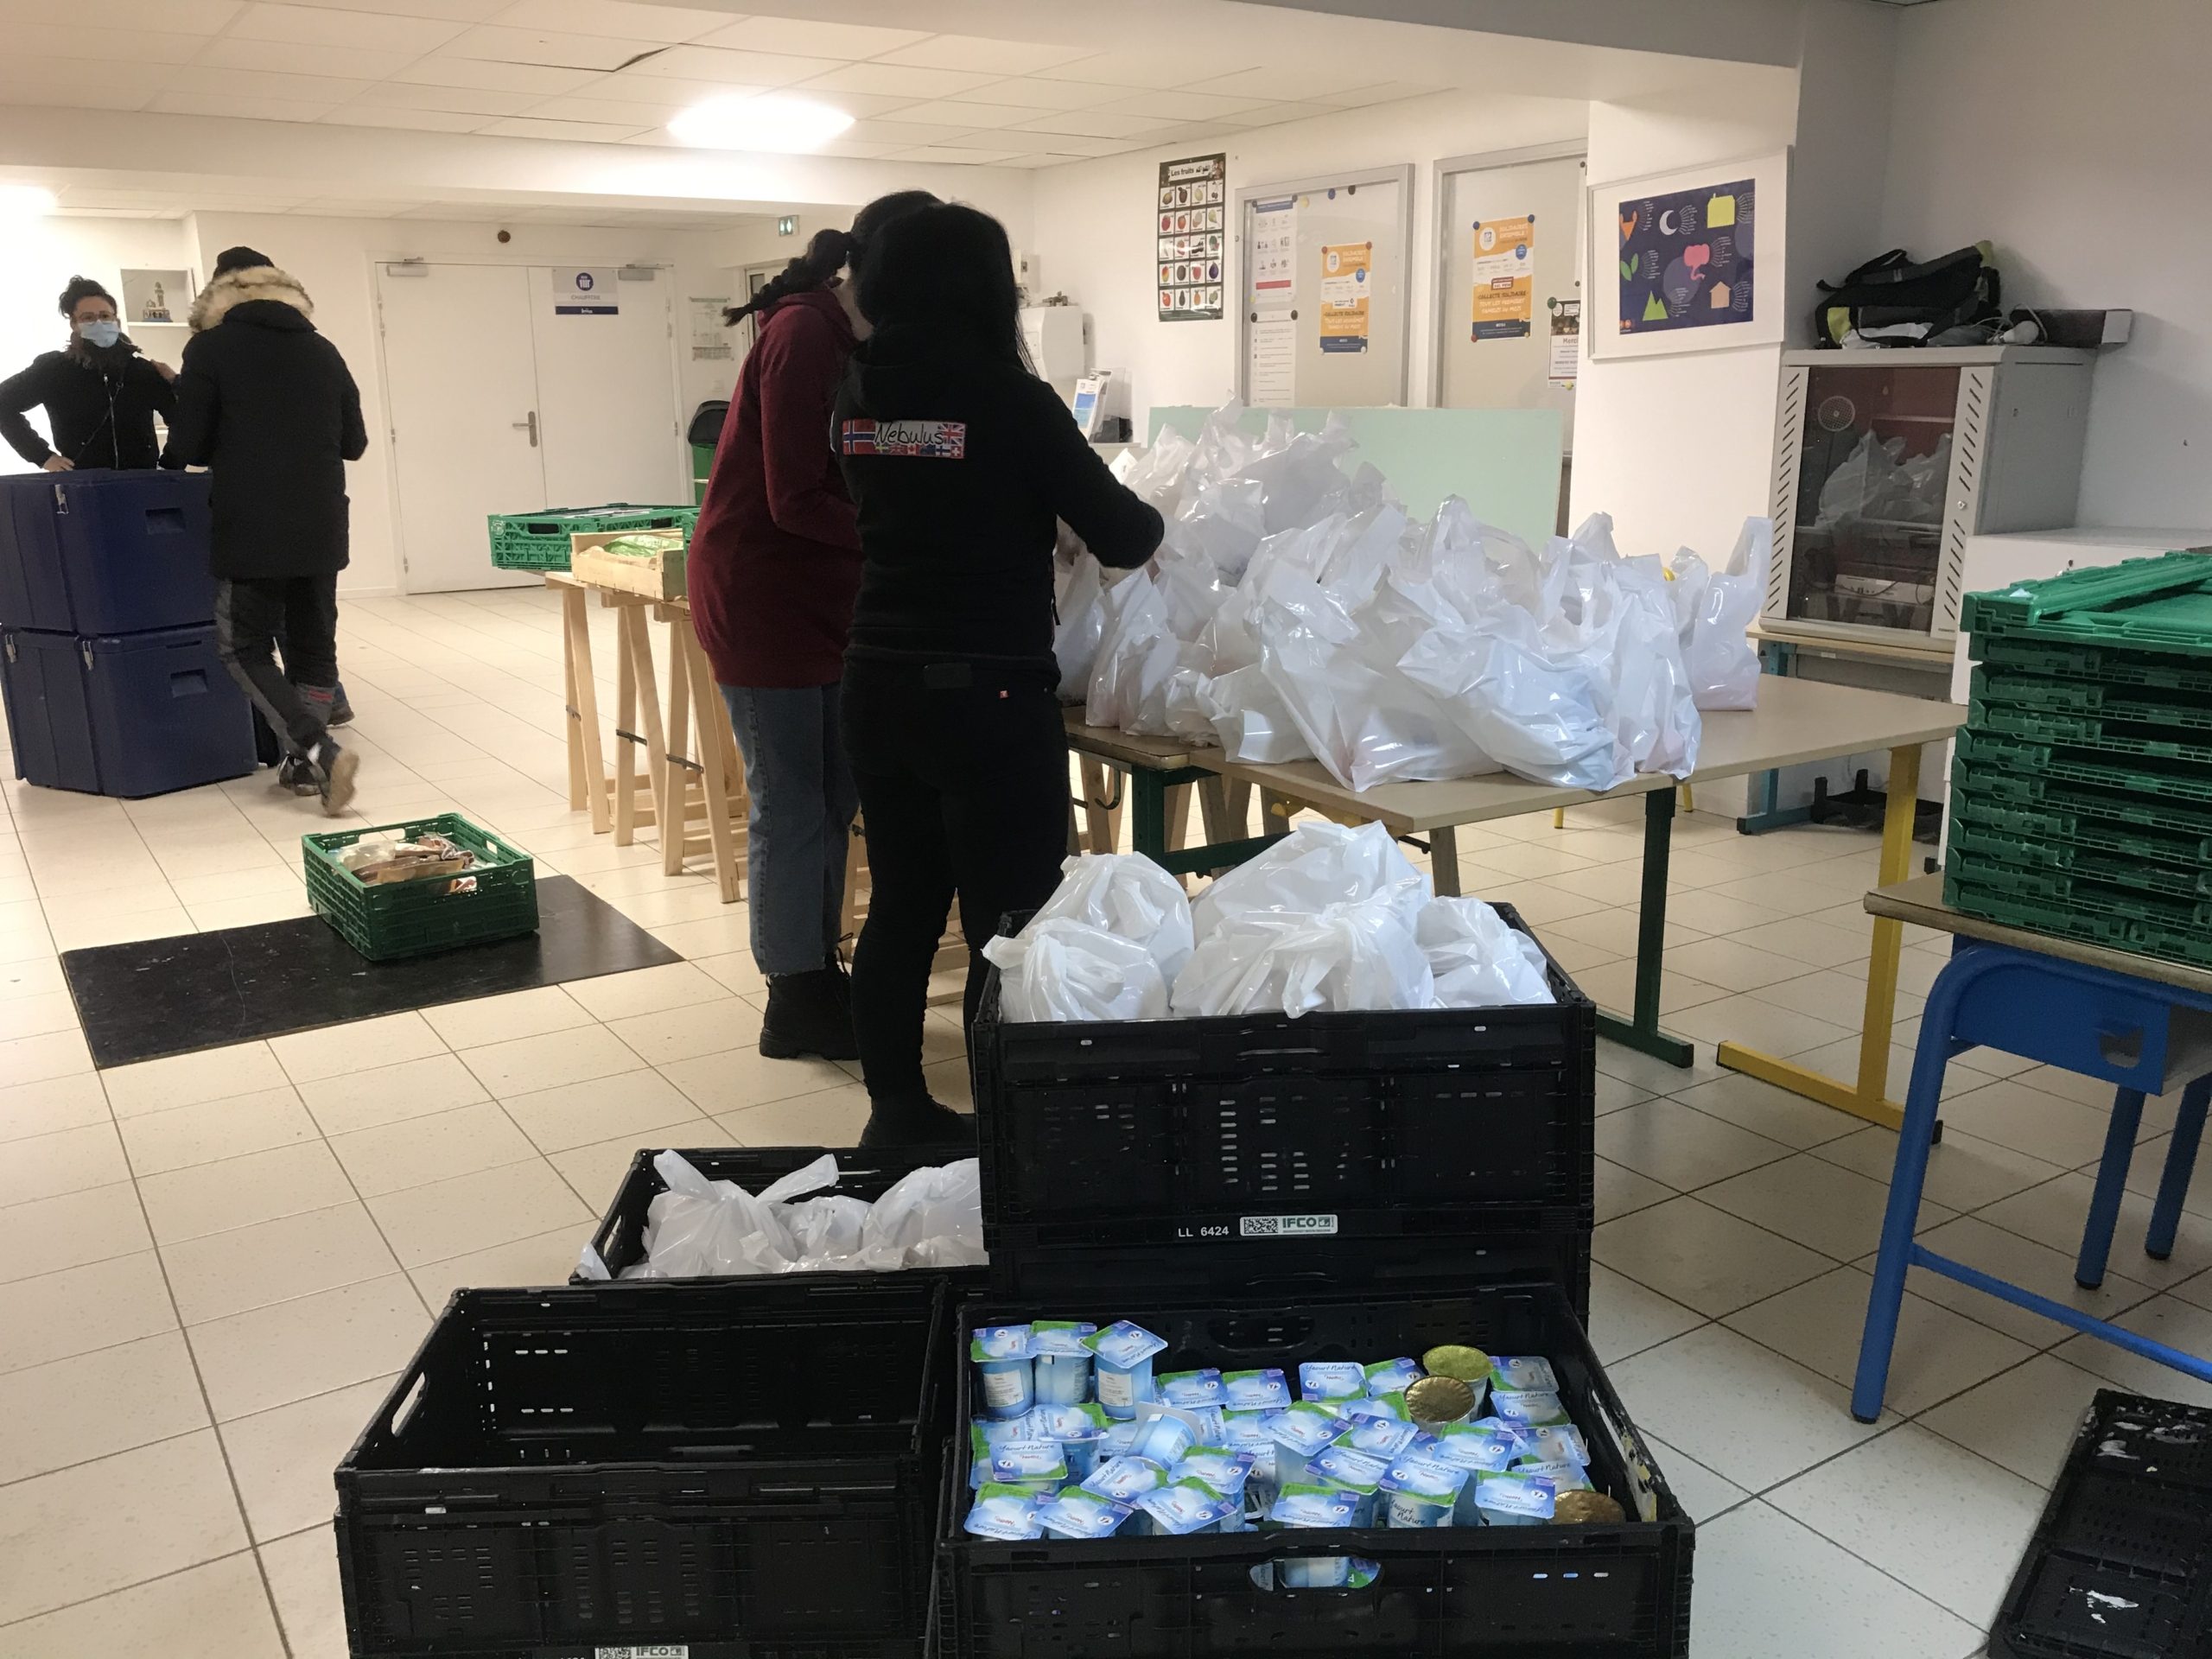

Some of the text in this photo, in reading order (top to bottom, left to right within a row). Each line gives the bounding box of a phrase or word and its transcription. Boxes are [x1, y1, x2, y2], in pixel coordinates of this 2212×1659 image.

[874, 422, 944, 445] Nebulus
[1282, 1217, 1317, 1228] IFCO
[1178, 1225, 1230, 1237] LL 6424
[636, 1647, 668, 1656] IFCO
